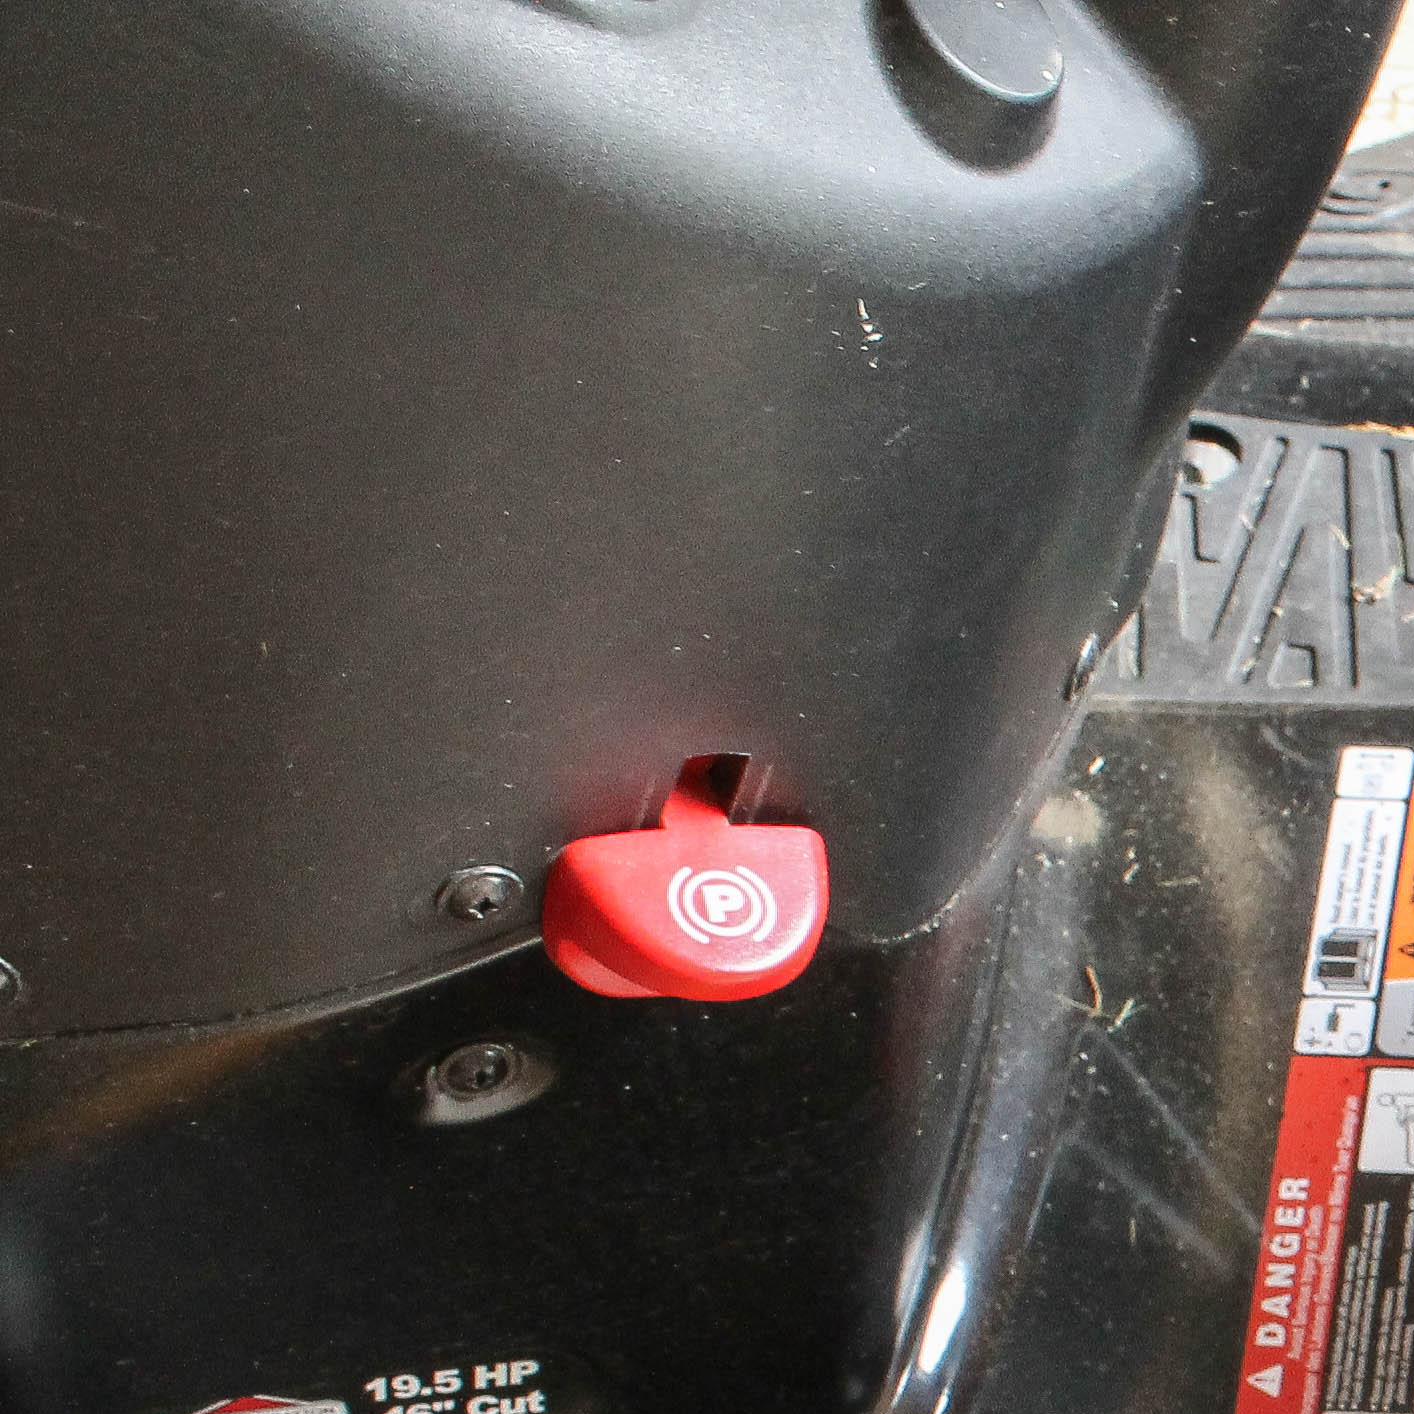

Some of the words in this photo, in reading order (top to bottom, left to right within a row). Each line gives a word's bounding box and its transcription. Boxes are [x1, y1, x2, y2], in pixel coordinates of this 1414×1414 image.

[701, 884, 744, 923] P
[1256, 1177, 1311, 1347] DANGER
[365, 1368, 463, 1402] 19.5
[473, 1360, 540, 1390] HP
